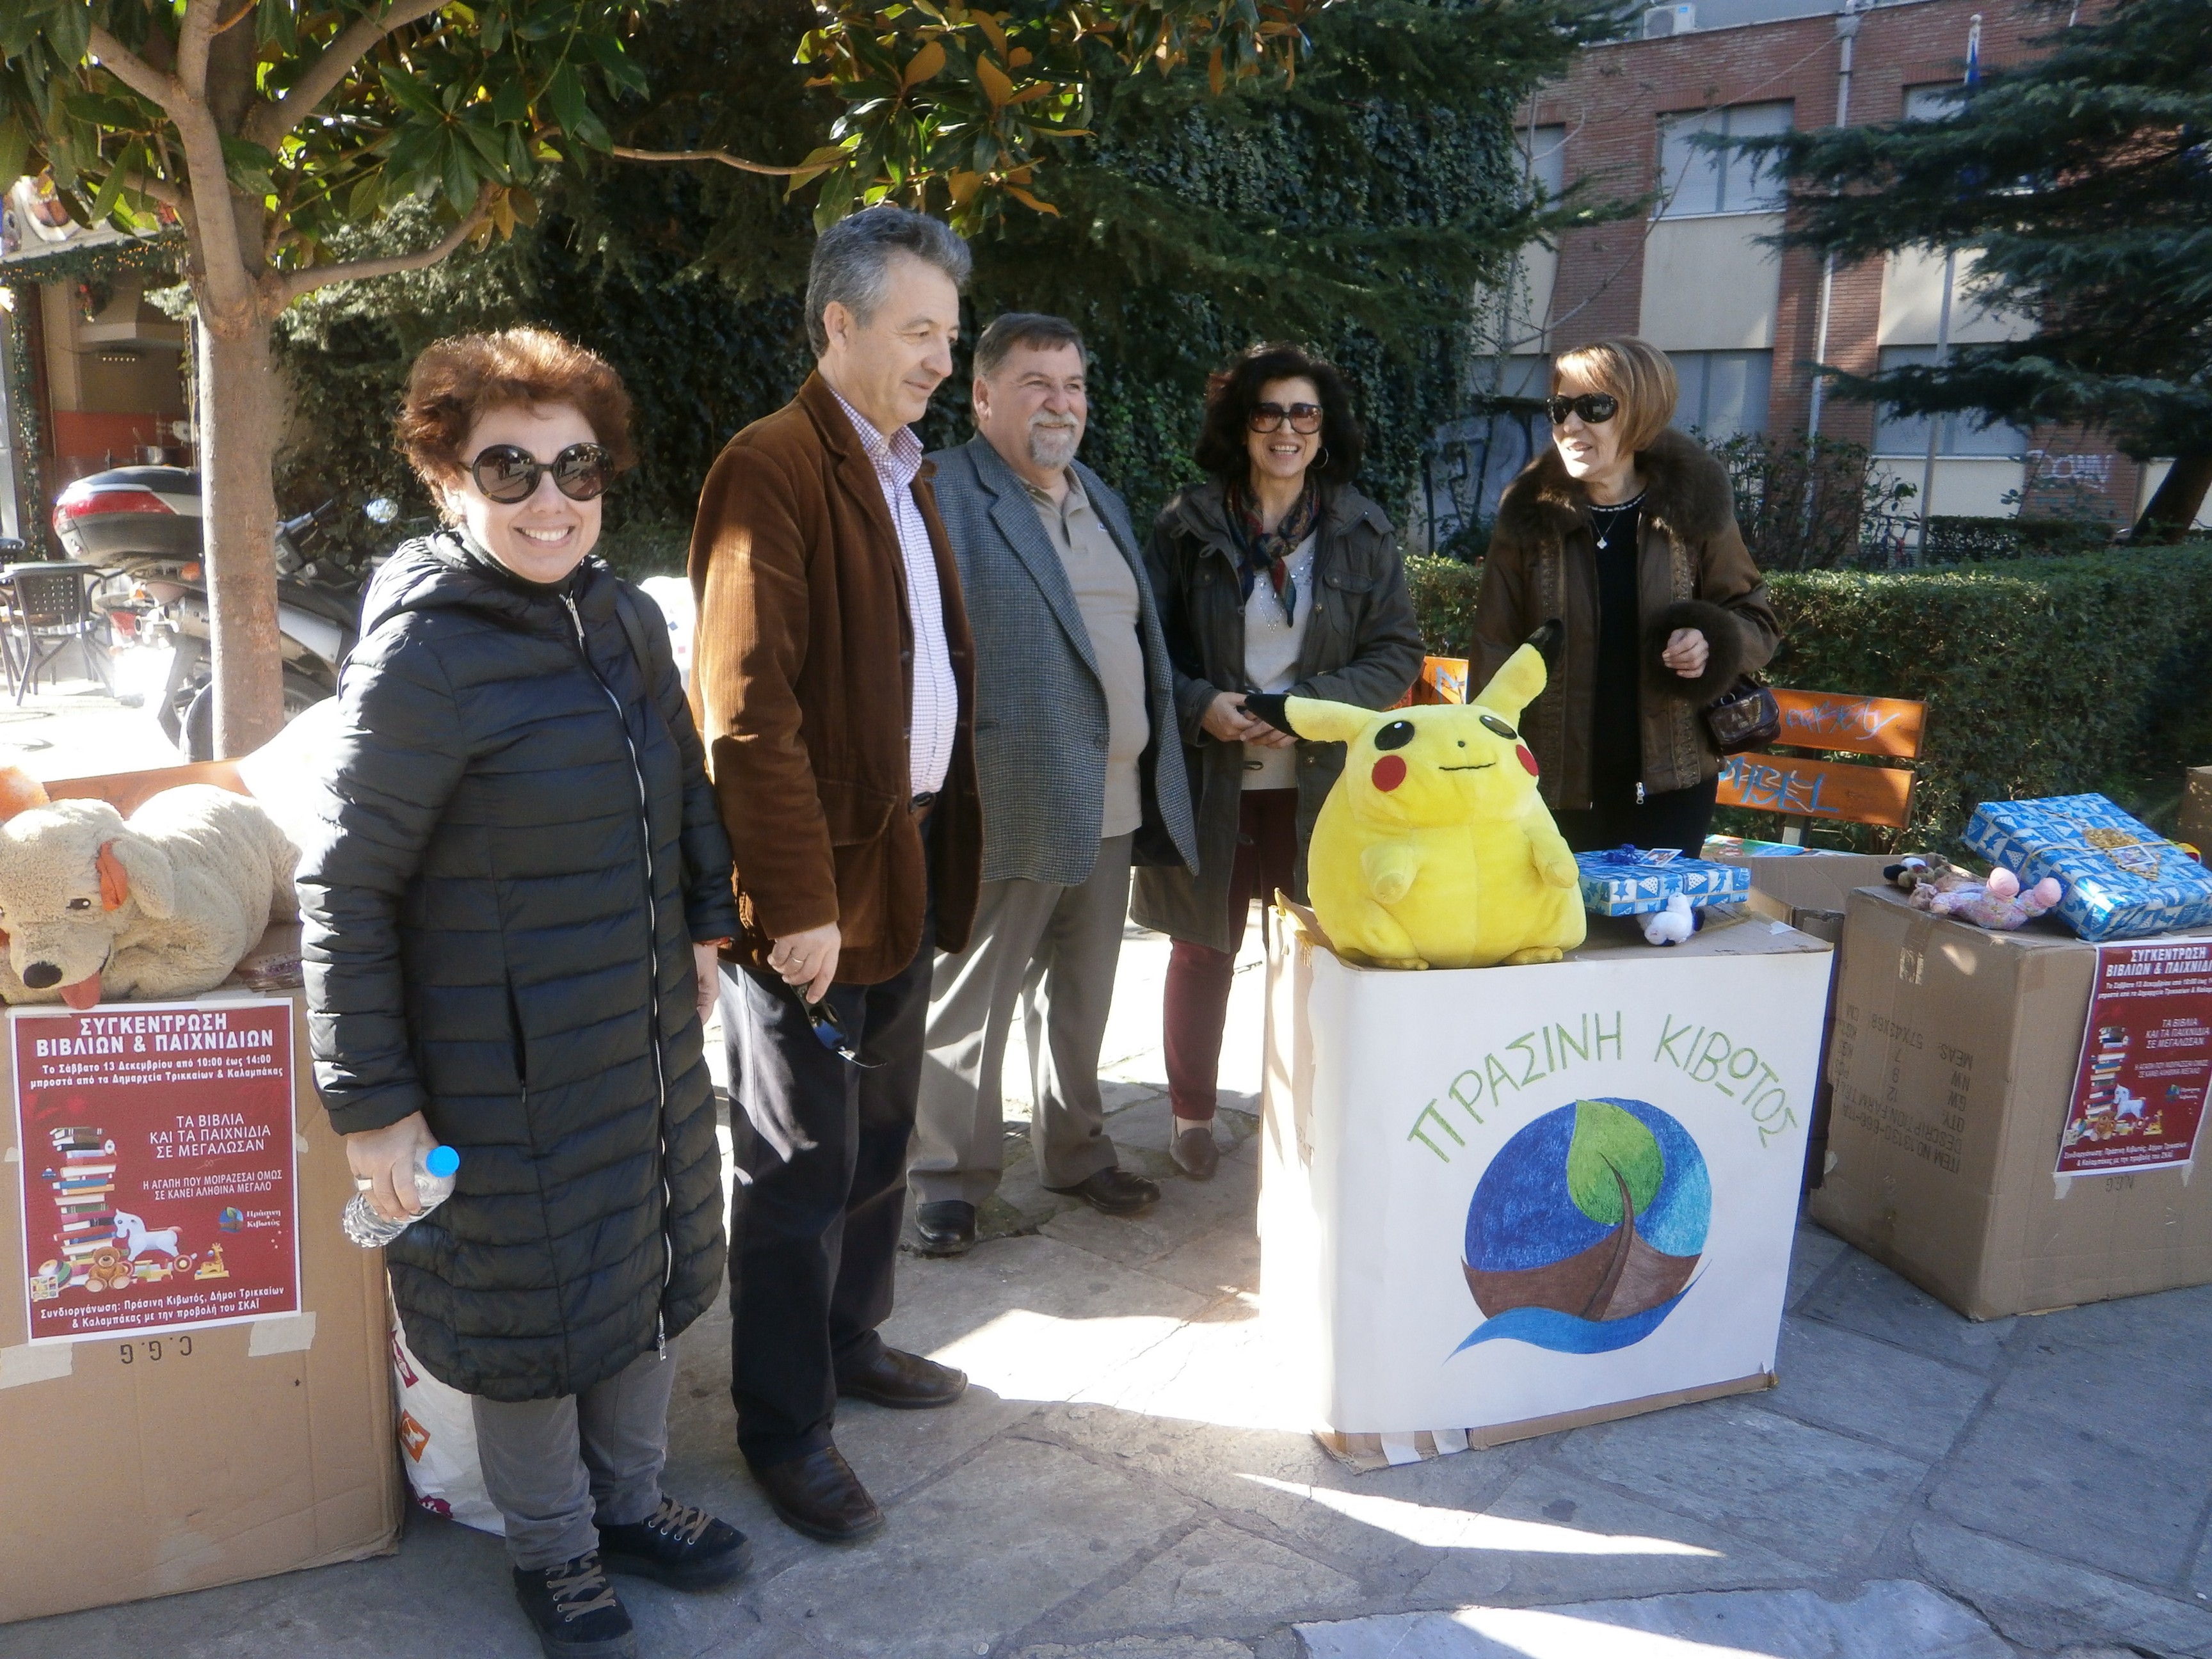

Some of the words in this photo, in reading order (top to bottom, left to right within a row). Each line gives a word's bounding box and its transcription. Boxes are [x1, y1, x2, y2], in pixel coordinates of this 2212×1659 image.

[2106, 963, 2151, 977] ΒΙΒΛΙΩΝ
[2154, 962, 2162, 974] &
[2165, 959, 2212, 974] ΠΑΙΧΝΙΔΙ
[80, 1013, 227, 1036] ΣΥΓΚΕΝΤΡΩΣΗ
[36, 1036, 124, 1057] ΒΙΒΛΙΩΝ
[133, 1035, 147, 1052] &
[156, 1029, 273, 1052] ΠΑΙΧΝΙΔΙΩΝ
[42, 1064, 55, 1074] Το
[59, 1062, 100, 1075] Σάββατο
[103, 1061, 115, 1071] 13
[118, 1059, 173, 1071] Δεκεμβρίου
[176, 1058, 193, 1068] από
[196, 1057, 222, 1067] 10:00
[226, 1056, 243, 1067] έως
[246, 1054, 271, 1064] 14:00
[30, 1076, 73, 1089] μπροστά
[77, 1075, 95, 1085] από
[98, 1076, 109, 1084] τα
[112, 1071, 161, 1084] Δημαρχεία
[165, 1070, 214, 1082] Τρικκαίων
[217, 1069, 224, 1078] &
[227, 1067, 283, 1078] Καλαμπάκας
[1407, 1010, 1621, 1164] ΠΡΑΣΙΝΗ
[1654, 1013, 1798, 1148] ΚΙΒΩΤΟΣ
[176, 1115, 195, 1128] ΤΑ
[198, 1112, 244, 1127] ΒΙΒΛΙΑ
[150, 1131, 173, 1144] ΚΑΙ
[177, 1130, 196, 1142] ΤΑ
[200, 1125, 271, 1141] ΠΑΙΧΝΙΔΙΑ
[156, 1145, 173, 1158] ΣΕ
[179, 1139, 264, 1157] ΜΕΓΑΛΩΣΑΝ
[1934, 1148, 1960, 1174] ITEM
[143, 1180, 149, 1190] Η
[152, 1178, 180, 1189] ΑΓΑΠΗ
[183, 1176, 202, 1187] ΠΟΥ
[204, 1172, 255, 1185] ΜΟΙΡΑΖΕΣΑΙ
[257, 1169, 283, 1181] ΟΜΩΣ
[155, 1190, 166, 1201] ΣΕ
[168, 1188, 193, 1199] ΚΑΝΕΙ
[196, 1183, 235, 1197] ΑΛΗΘΙΝΑ
[237, 1181, 272, 1193] ΜΕΓΑΛΟ
[246, 1209, 281, 1218] Πράσινη
[246, 1219, 280, 1228] Κιβωτός
[40, 1302, 121, 1319] Συνδιοργάνωση:
[124, 1298, 163, 1311] Πράσινη
[166, 1292, 207, 1306] Κιβωτός,
[210, 1290, 236, 1301] Δήμοι
[239, 1286, 284, 1299] Τρικκαίων
[72, 1318, 79, 1329] &
[82, 1313, 141, 1327] Καλαμπάκας
[144, 1312, 155, 1322] με
[158, 1311, 173, 1321] την
[177, 1304, 217, 1319] προβολή
[220, 1303, 235, 1312] του
[238, 1297, 260, 1311] ΣΚΑΪ
